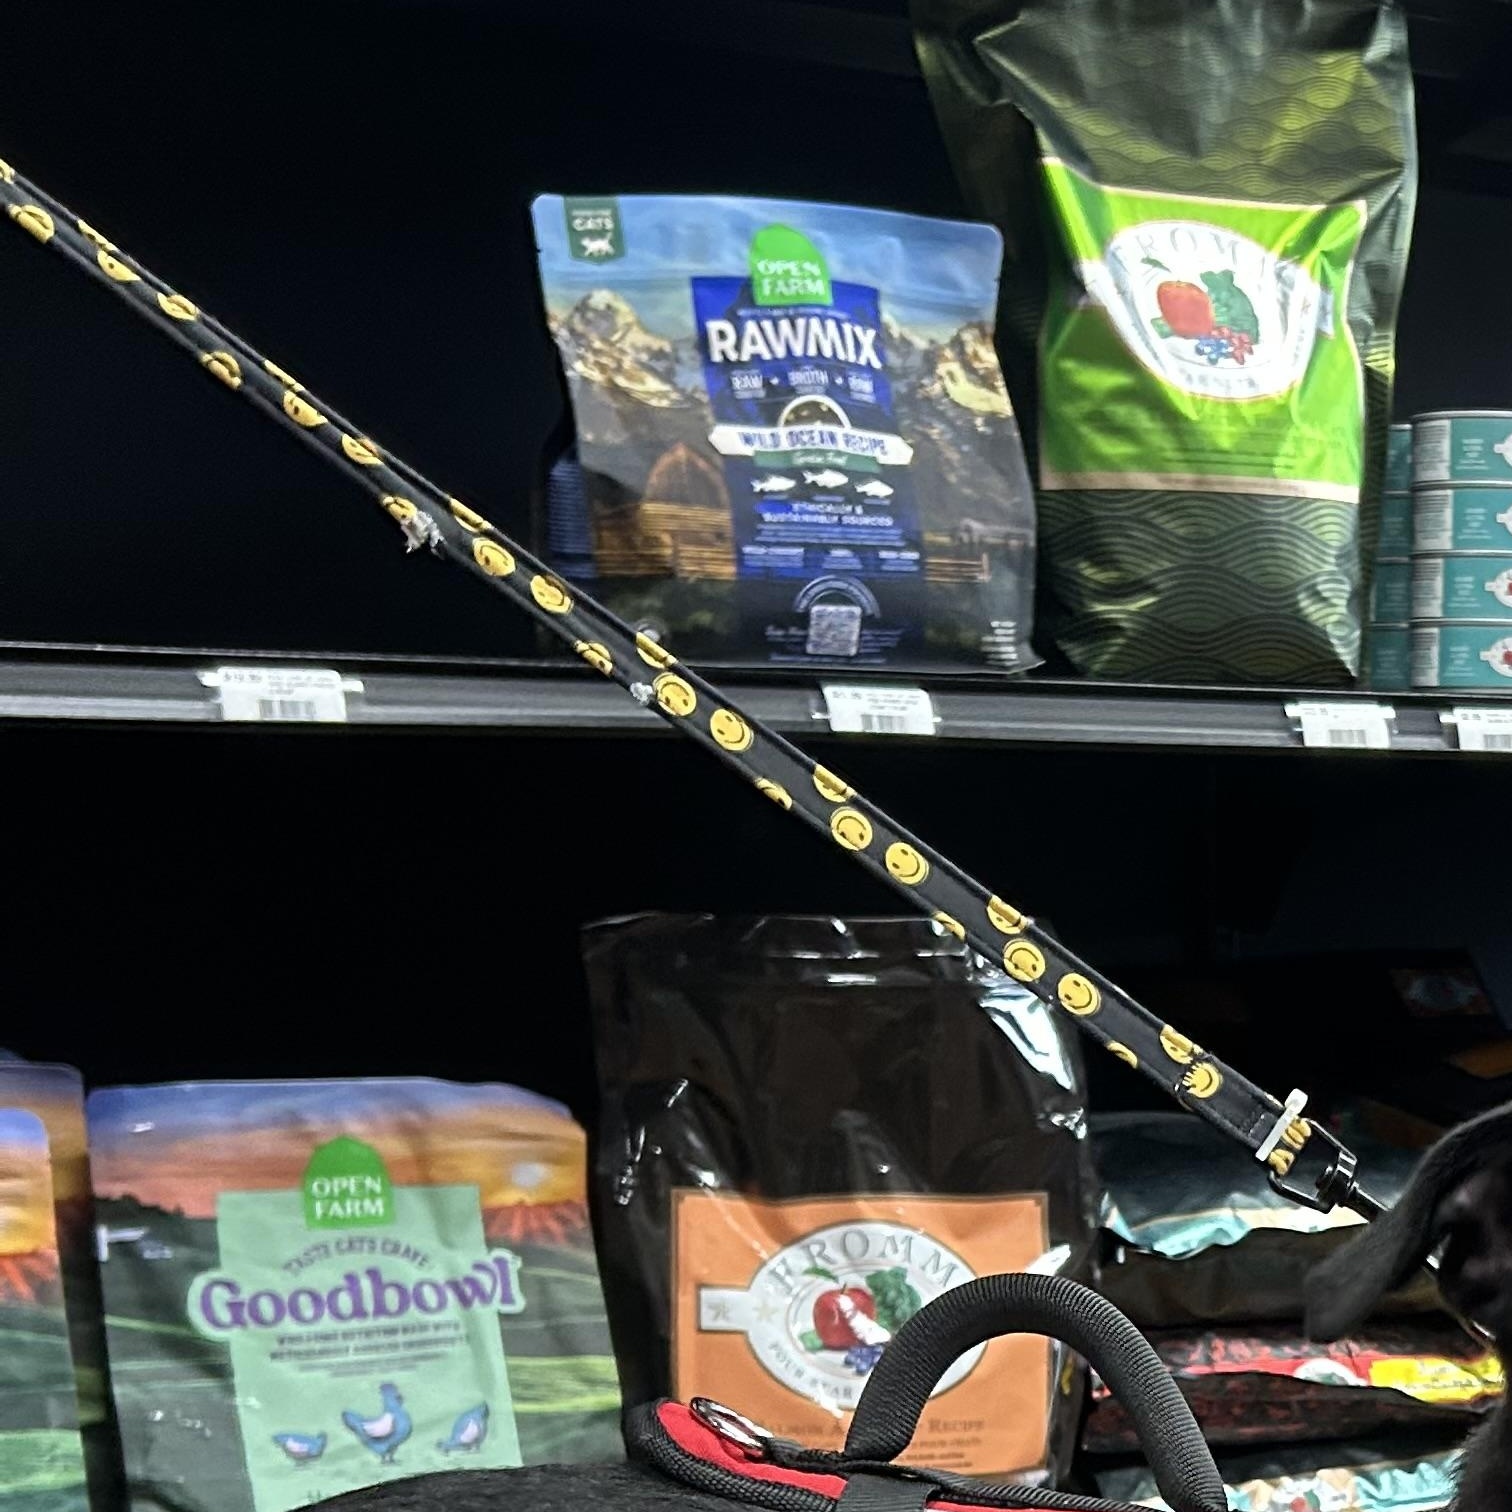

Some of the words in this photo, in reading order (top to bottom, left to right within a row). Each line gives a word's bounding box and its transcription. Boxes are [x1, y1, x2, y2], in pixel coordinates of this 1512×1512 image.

[572, 216, 615, 231] CATS
[756, 258, 821, 277] OPEN
[760, 277, 826, 297] FARM
[705, 315, 883, 370] RAWMIX
[311, 1175, 382, 1198] OPEN
[314, 1198, 385, 1221] FARM
[335, 1235, 377, 1256] CATS
[381, 1238, 431, 1269] CRAVE
[767, 1228, 960, 1296] FROMM
[199, 1254, 517, 1330] Goodbowl
